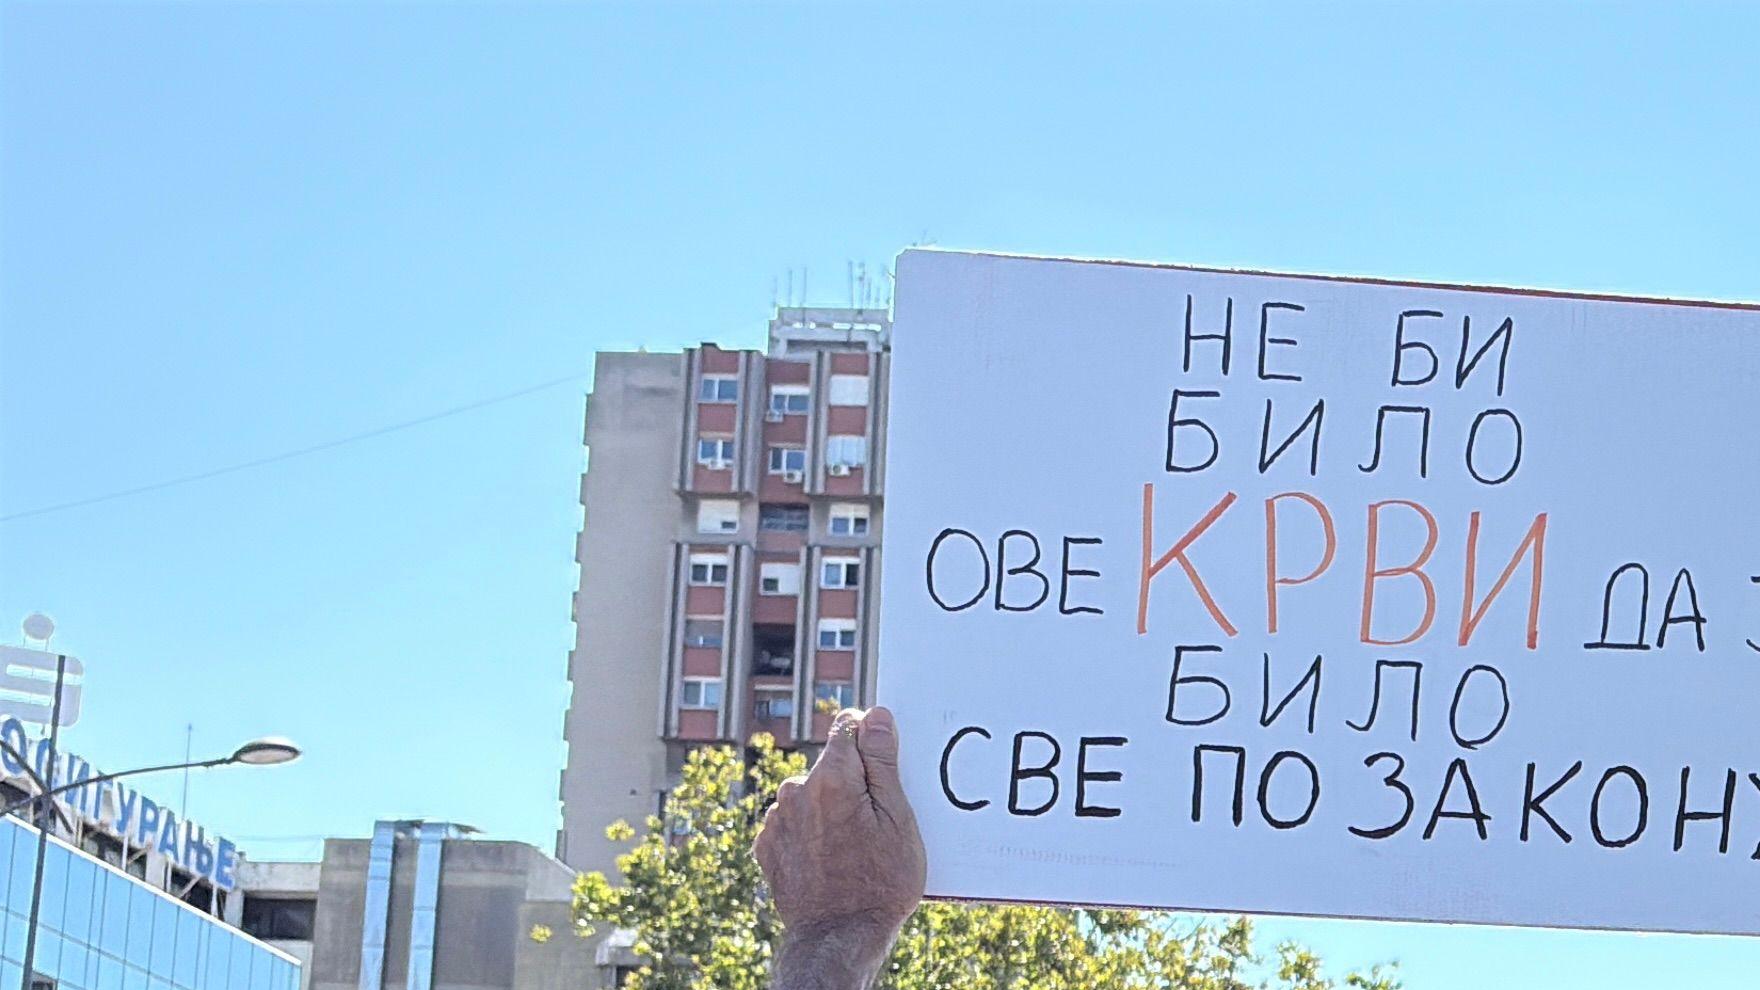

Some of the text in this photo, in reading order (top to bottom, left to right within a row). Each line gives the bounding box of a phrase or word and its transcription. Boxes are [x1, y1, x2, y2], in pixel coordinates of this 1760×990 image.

[1182, 294, 1514, 397] НЕ БИ
[1165, 388, 1524, 487] БИЛО
[926, 527, 1105, 616] ОВЕ
[1135, 483, 1549, 650] КРВИ
[1583, 562, 1708, 653] ДА
[1165, 644, 1512, 751] БИЛО
[939, 726, 1129, 818] СВЕ
